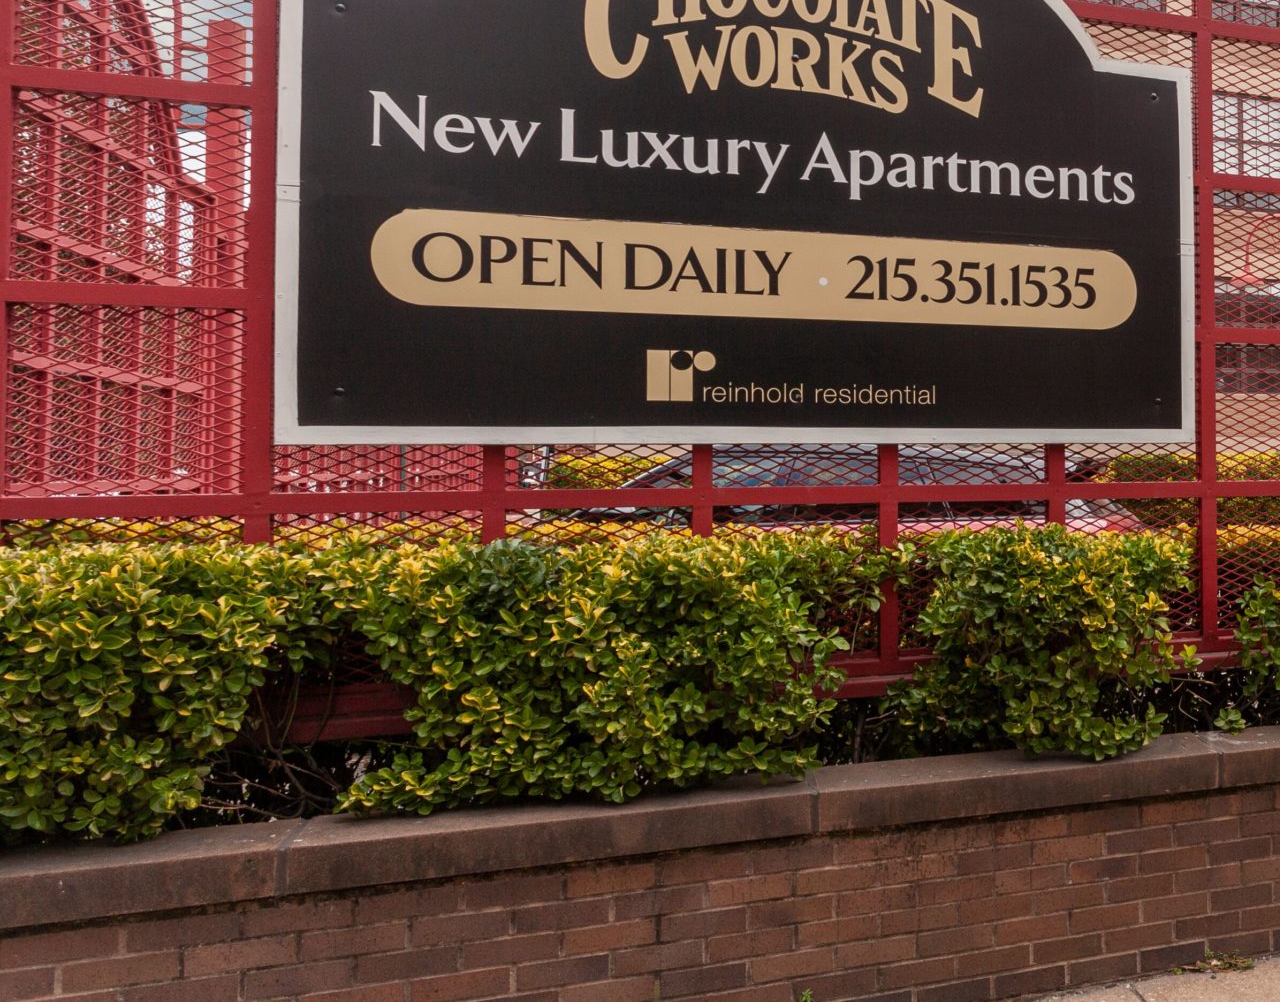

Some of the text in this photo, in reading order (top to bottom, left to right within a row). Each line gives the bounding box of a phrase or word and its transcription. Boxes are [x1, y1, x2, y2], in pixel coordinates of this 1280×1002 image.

[663, 24, 909, 114] WORKS
[369, 89, 1136, 205] New Luxury Apartments
[411, 232, 1097, 310] OPEN DAILY 215.351.1535
[702, 381, 936, 406] reinhold residential
